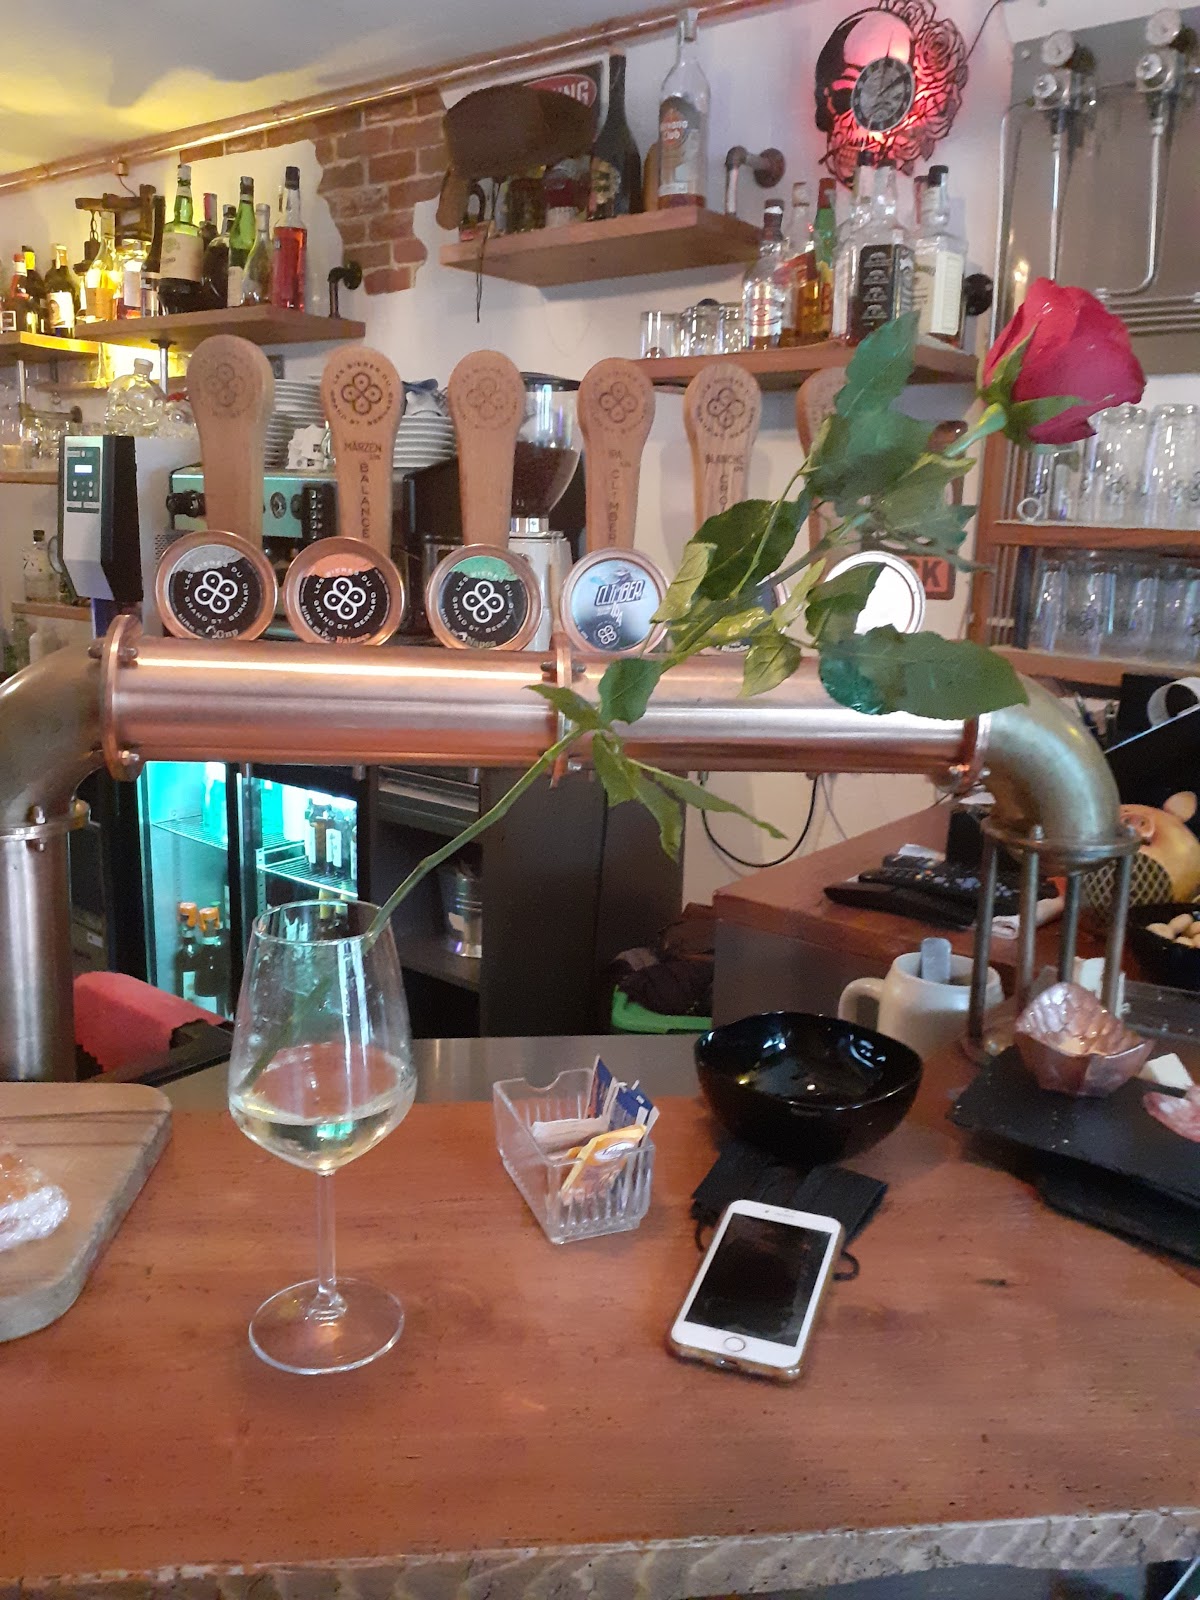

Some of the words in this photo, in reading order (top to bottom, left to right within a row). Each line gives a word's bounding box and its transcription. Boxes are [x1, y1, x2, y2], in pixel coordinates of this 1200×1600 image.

[359, 462, 370, 539] BALANCE
[184, 572, 194, 590] LES
[231, 566, 243, 578] DU
[314, 578, 325, 594] LES
[361, 575, 373, 587] DU
[455, 576, 469, 592] LES
[504, 584, 513, 597] DU
[184, 596, 208, 622] GRAND
[228, 582, 250, 622] BERNARD
[595, 580, 645, 606] CLIMBER
[313, 599, 335, 627] GRAND
[354, 591, 377, 628] BERNARD
[452, 596, 468, 626] GRAND
